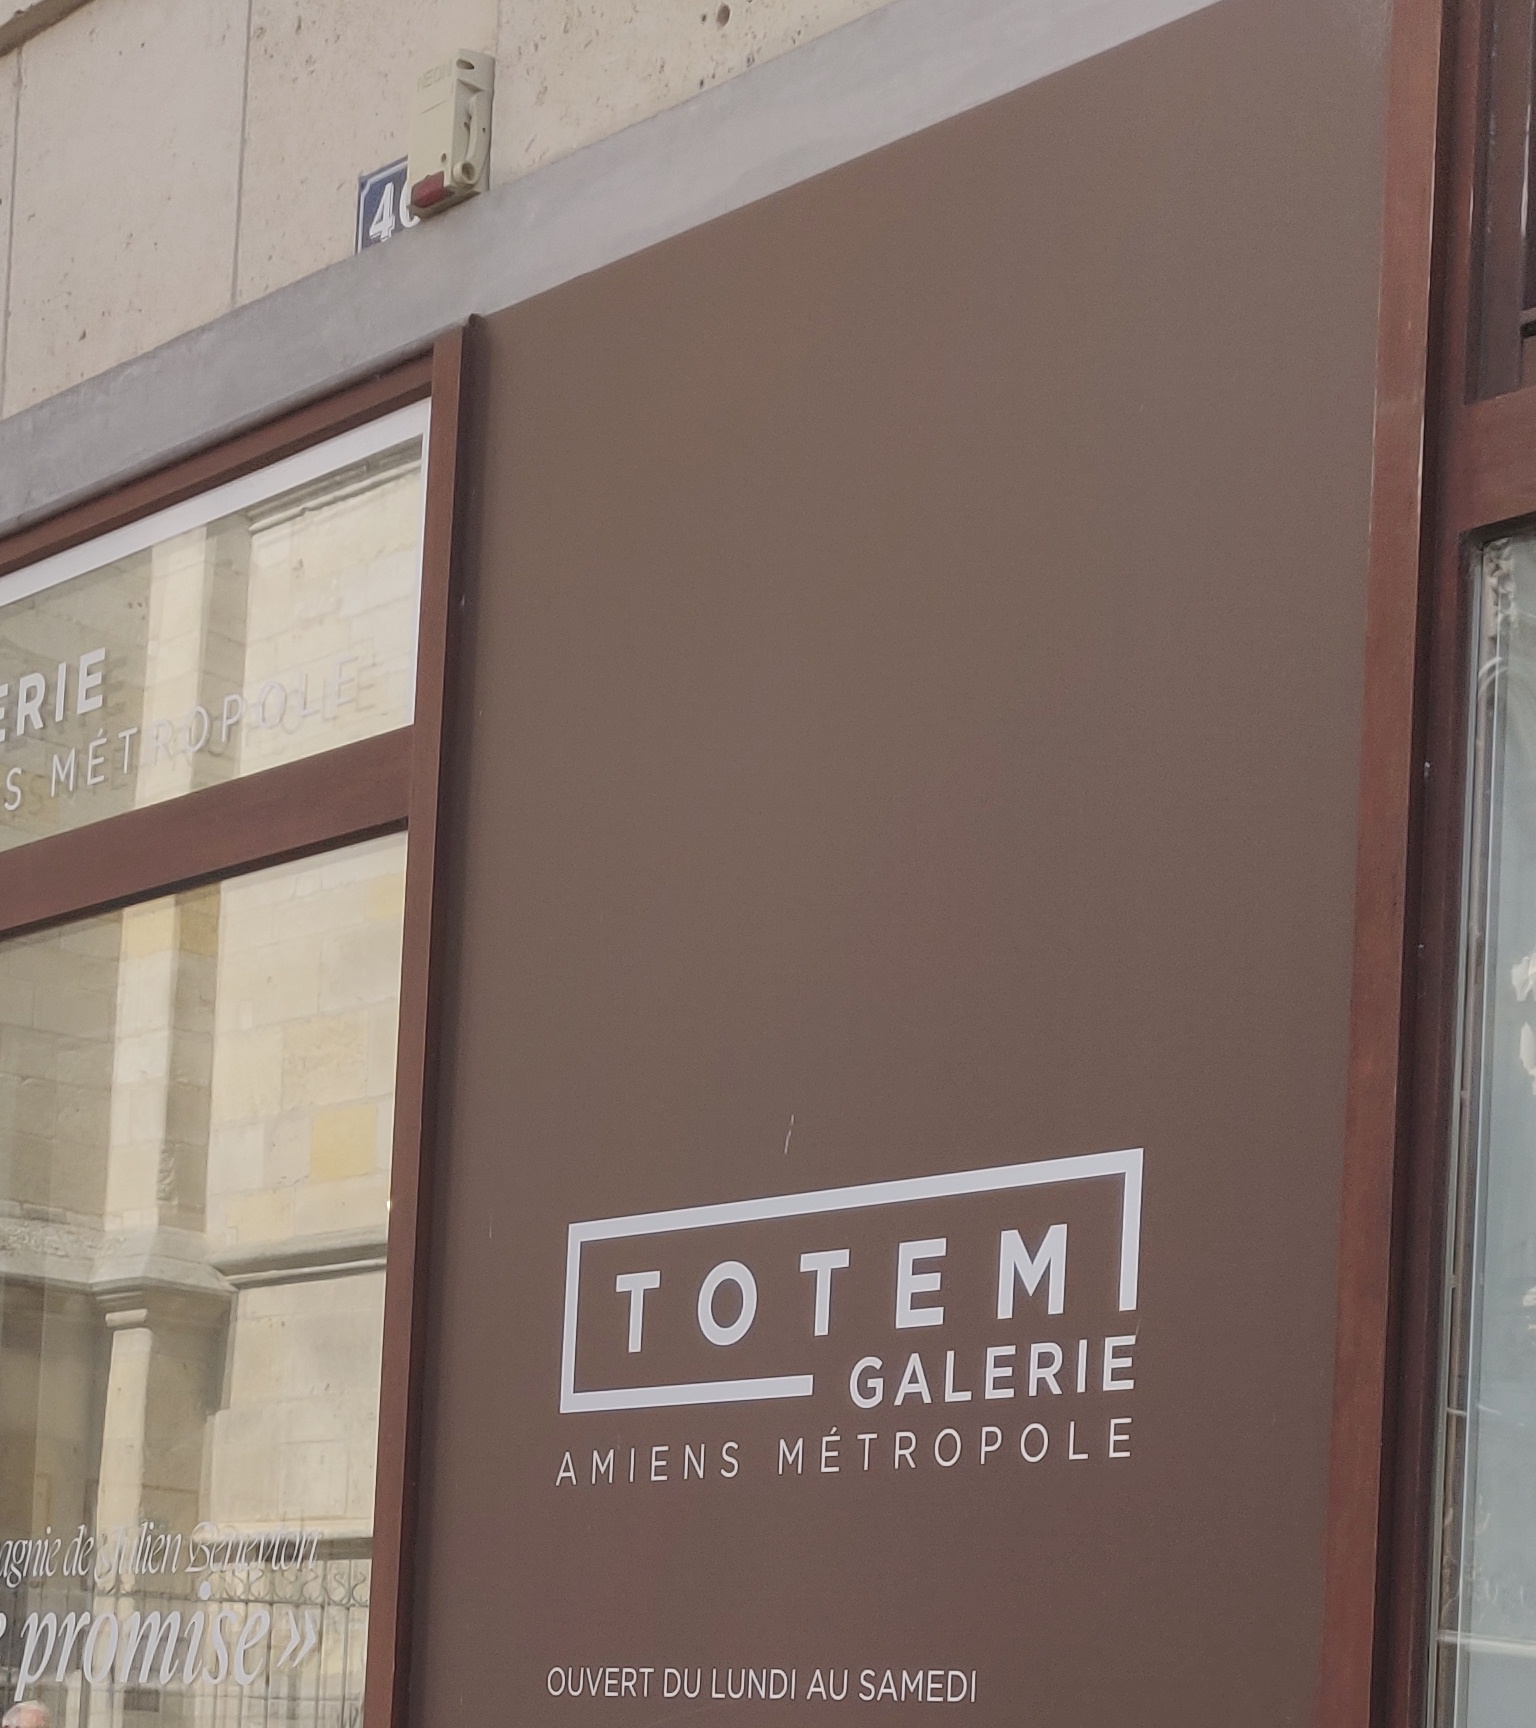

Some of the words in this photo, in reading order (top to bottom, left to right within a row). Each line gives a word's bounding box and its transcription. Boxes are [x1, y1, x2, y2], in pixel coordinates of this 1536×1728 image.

[50, 654, 360, 798] MÉTROPOLE
[616, 1223, 1068, 1354] TOTEM
[849, 1335, 1137, 1410] GALERIE
[555, 1441, 741, 1487] AMIENS
[777, 1417, 1133, 1476] MÉTROPOLE
[63, 1523, 95, 1577] de
[94, 1520, 182, 1583] Julien
[546, 1666, 655, 1698] OUVERT
[664, 1667, 702, 1699] DU
[710, 1668, 796, 1700] LUNDI
[806, 1668, 849, 1701] AU
[858, 1669, 977, 1703] SAMEDI
